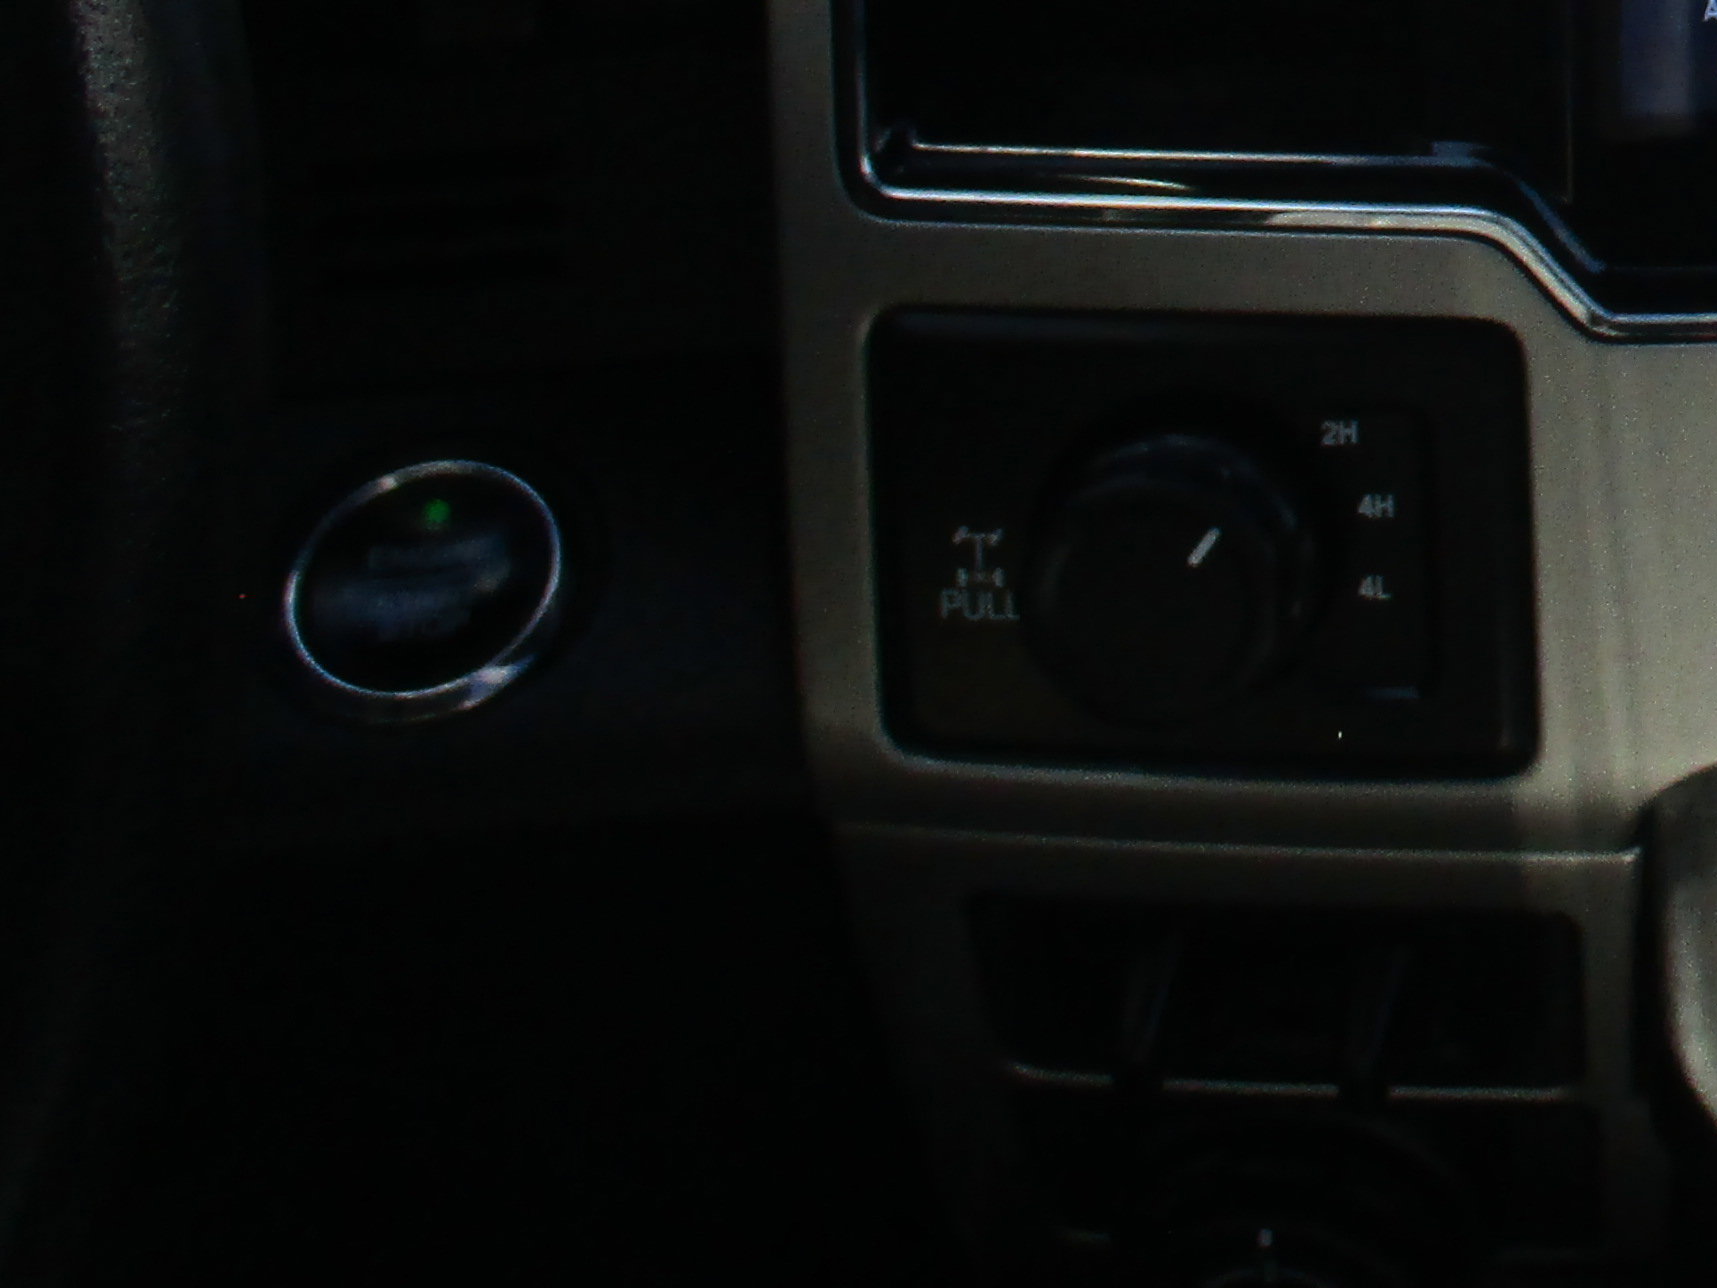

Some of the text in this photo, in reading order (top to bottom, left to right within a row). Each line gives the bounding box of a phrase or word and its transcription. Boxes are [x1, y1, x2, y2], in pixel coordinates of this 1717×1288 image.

[1322, 421, 1358, 445] 2H
[1357, 494, 1394, 519] 4H
[1359, 576, 1391, 600] 4L
[941, 590, 1020, 621] PULL
